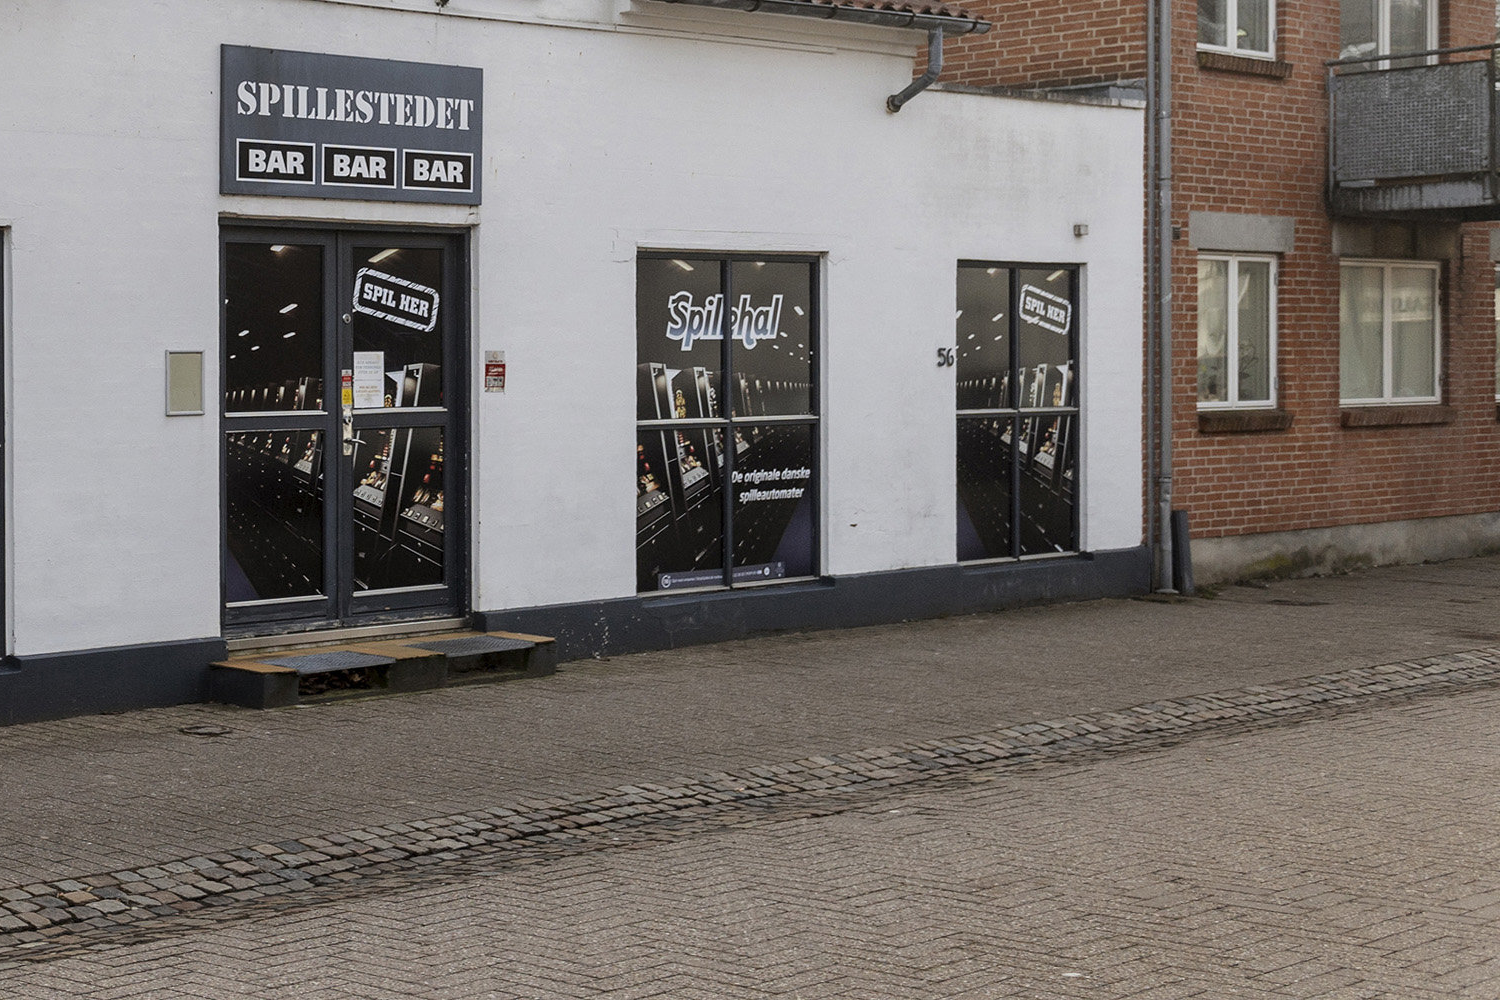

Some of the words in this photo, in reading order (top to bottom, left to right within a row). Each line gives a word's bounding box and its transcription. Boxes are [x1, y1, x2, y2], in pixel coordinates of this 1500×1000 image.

[237, 80, 474, 131] SPILLESTEDET
[248, 149, 305, 175] BAR
[333, 153, 387, 179] BAR
[413, 158, 464, 183] BAR
[363, 282, 396, 308] SPIL
[398, 293, 430, 318] HER
[1024, 296, 1046, 316] SPIL
[1046, 304, 1066, 324] HER
[665, 290, 784, 351] Spilhal
[937, 347, 955, 368] 56
[731, 470, 744, 484] De
[744, 468, 781, 484] originale
[781, 466, 811, 480] danske
[739, 487, 804, 504] spilleautomater
